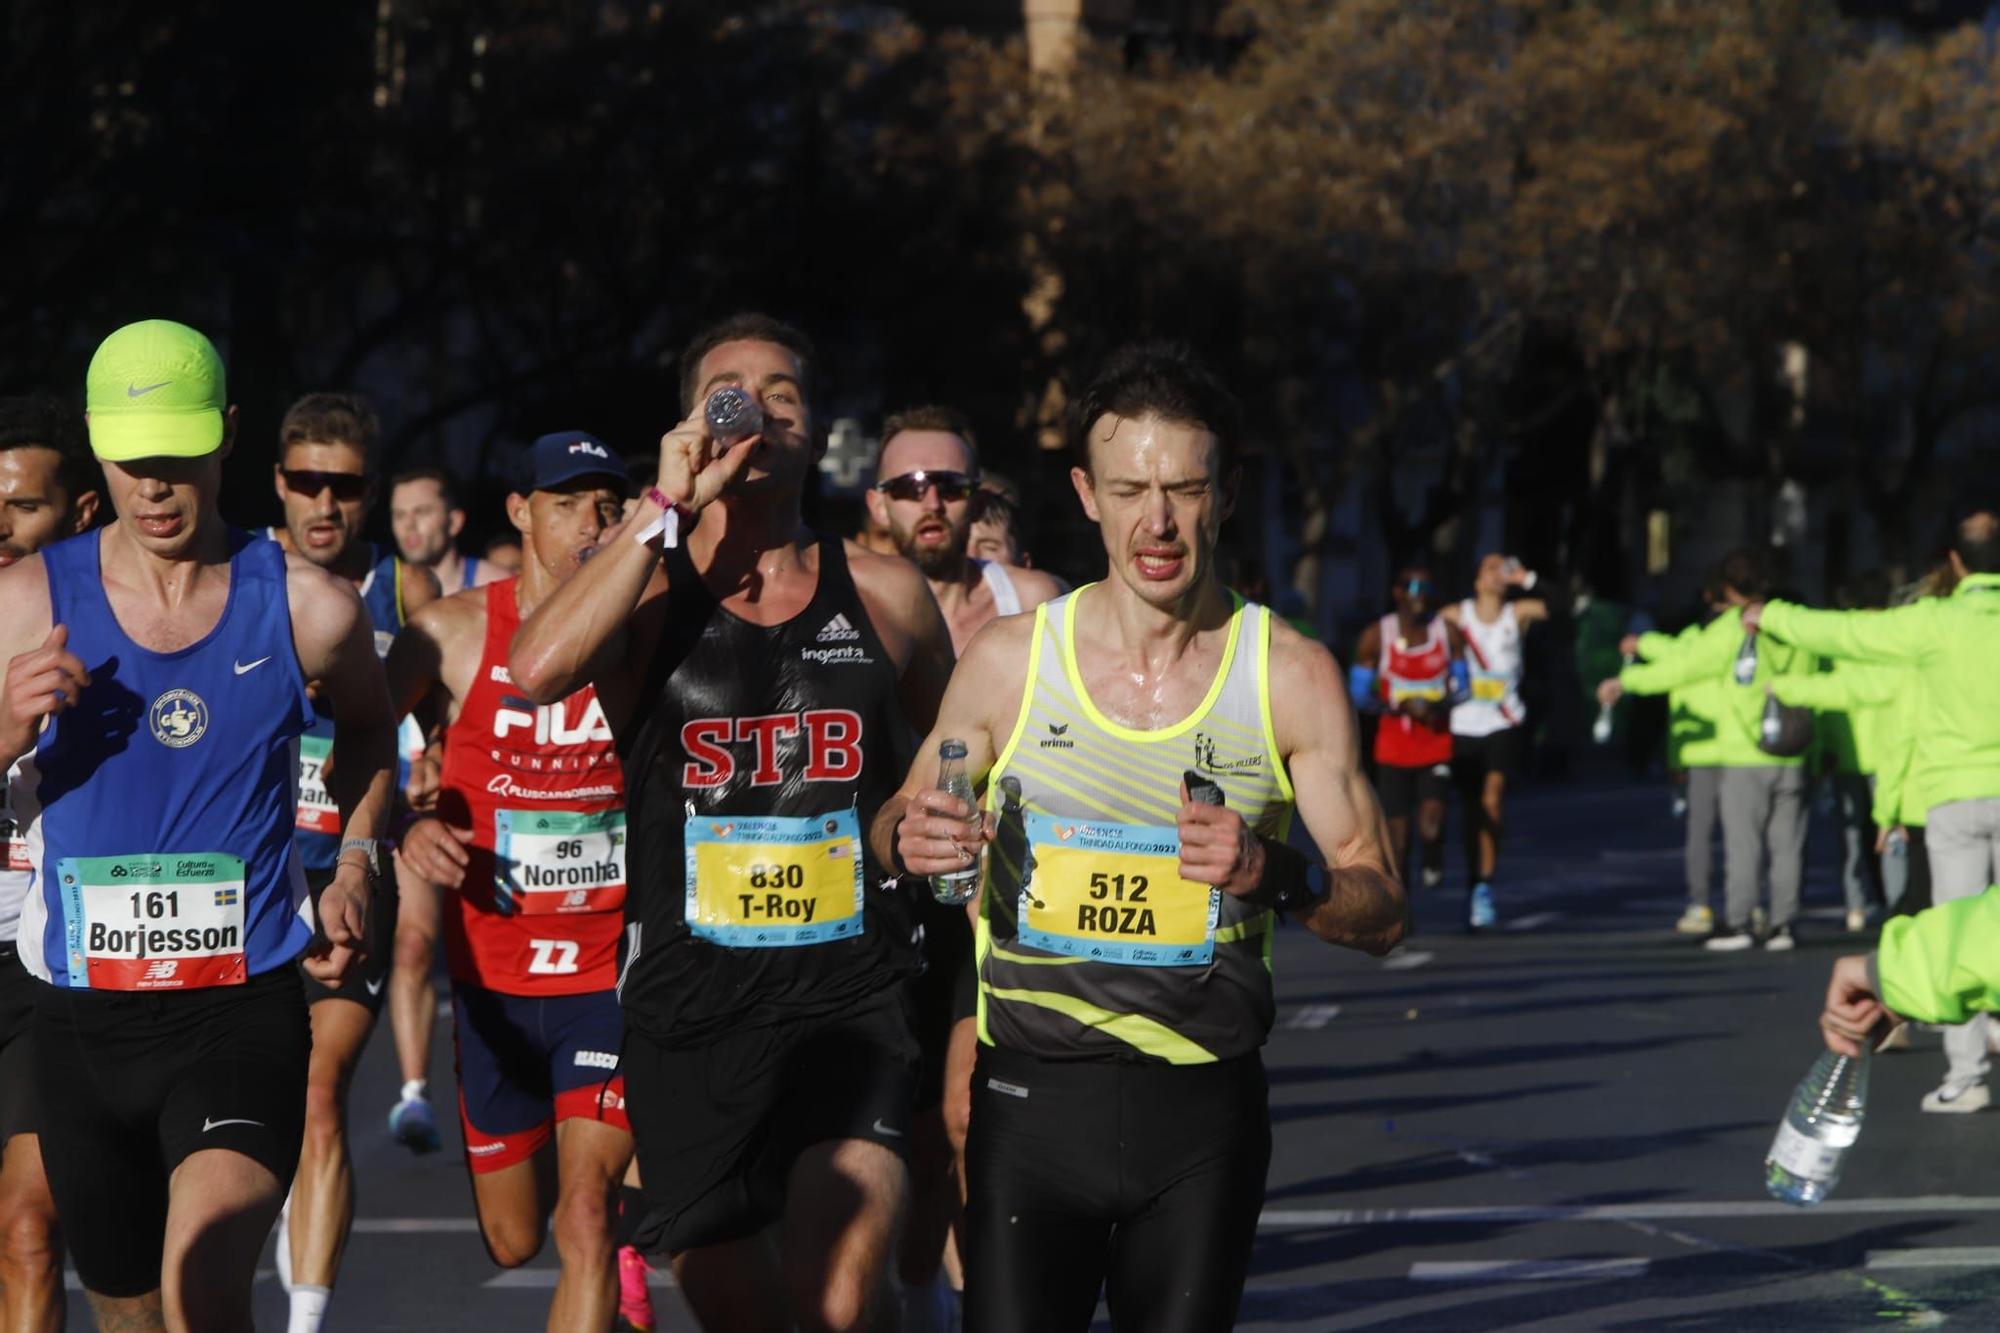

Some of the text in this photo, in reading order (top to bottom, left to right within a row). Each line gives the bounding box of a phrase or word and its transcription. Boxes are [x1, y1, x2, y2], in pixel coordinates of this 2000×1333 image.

[816, 628, 860, 642] adidas
[801, 645, 864, 664] ingenta
[493, 696, 613, 746] FILA
[681, 708, 863, 788] STB
[1040, 738, 1074, 748] erima
[491, 750, 615, 769] RUNNING
[556, 840, 582, 858] 96
[177, 861, 207, 869] Cultura
[524, 862, 620, 887] Noronha
[751, 864, 803, 889] 830
[1090, 873, 1148, 903] 512
[130, 891, 178, 919] 161
[738, 894, 817, 922] T-Roy
[1077, 905, 1157, 936] ROZA
[89, 922, 237, 958] Borjesson
